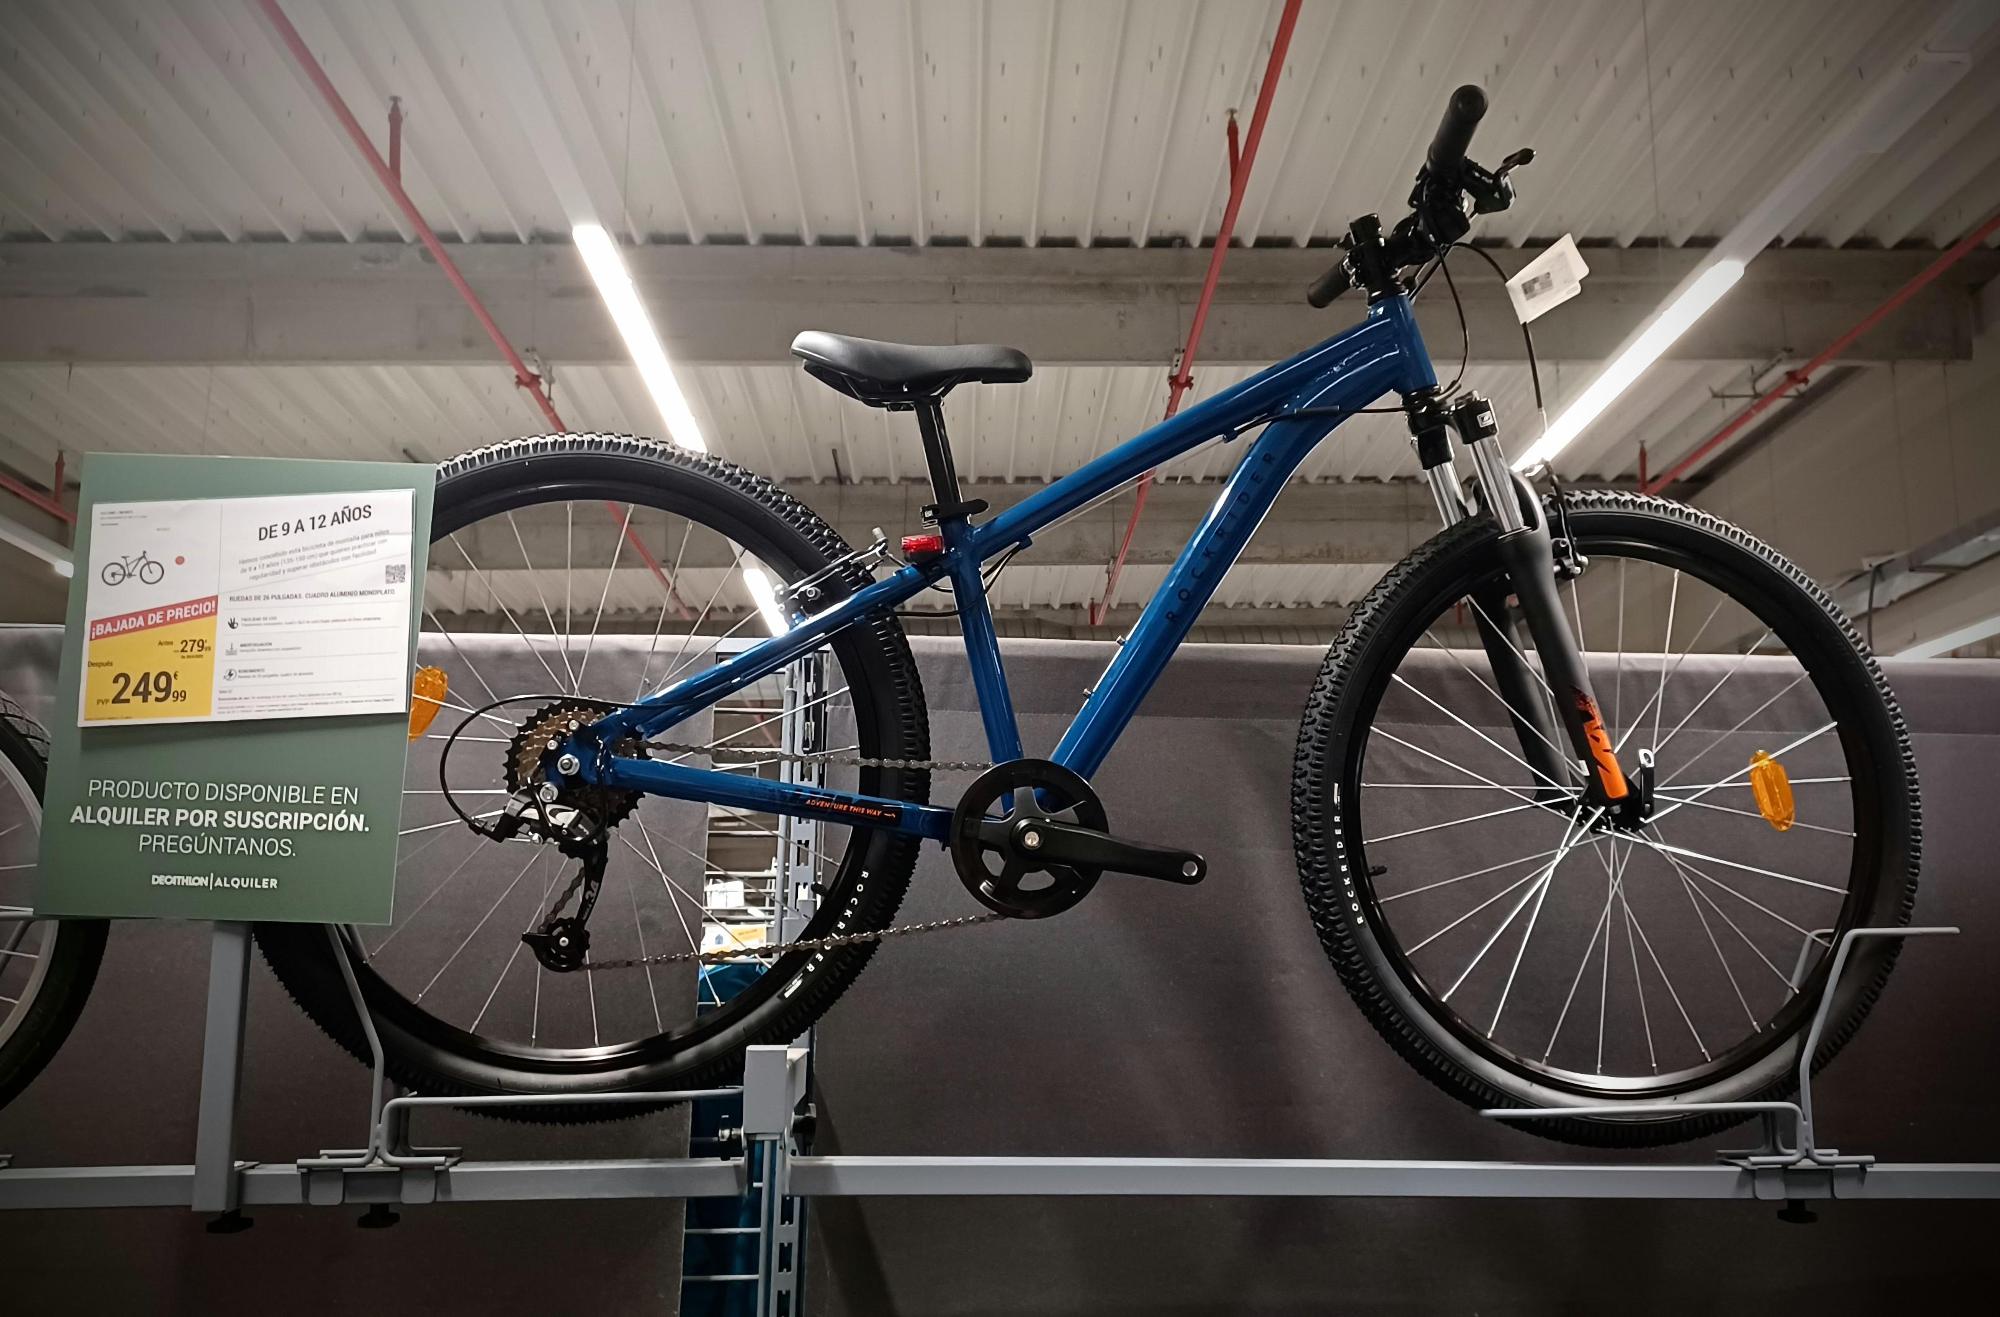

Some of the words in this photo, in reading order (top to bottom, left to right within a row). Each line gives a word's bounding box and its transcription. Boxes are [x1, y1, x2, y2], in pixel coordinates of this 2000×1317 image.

[258, 523, 279, 541] DE
[281, 521, 290, 536] 9
[294, 518, 305, 534] A
[309, 514, 327, 530] 12
[330, 504, 372, 526] AÑOS
[229, 595, 252, 603] RUEDAS
[305, 590, 329, 600] CUADRO
[330, 589, 359, 599] ALUMINIO
[91, 615, 145, 640] ¡BAJADA
[147, 612, 164, 626] DE
[166, 600, 216, 622] PRECIO!
[180, 639, 205, 653] 279
[87, 660, 114, 669] Después
[111, 671, 173, 705] 249
[172, 690, 187, 703] 99
[88, 779, 200, 801] PRODUCTO
[205, 783, 326, 805] DISPONIBLE
[331, 787, 359, 805] EN
[70, 805, 169, 826] ALQUILER
[175, 808, 218, 828] POR
[223, 808, 370, 833] SUSCRIPCIÓN.
[805, 799, 849, 811] ADVENTURE
[849, 805, 865, 814] THIS
[866, 808, 882, 817] WAY
[139, 832, 297, 857] PREGÚNTANOS.
[1333, 815, 1365, 925] ROCKRIDER
[214, 877, 278, 889] ALQUILER
